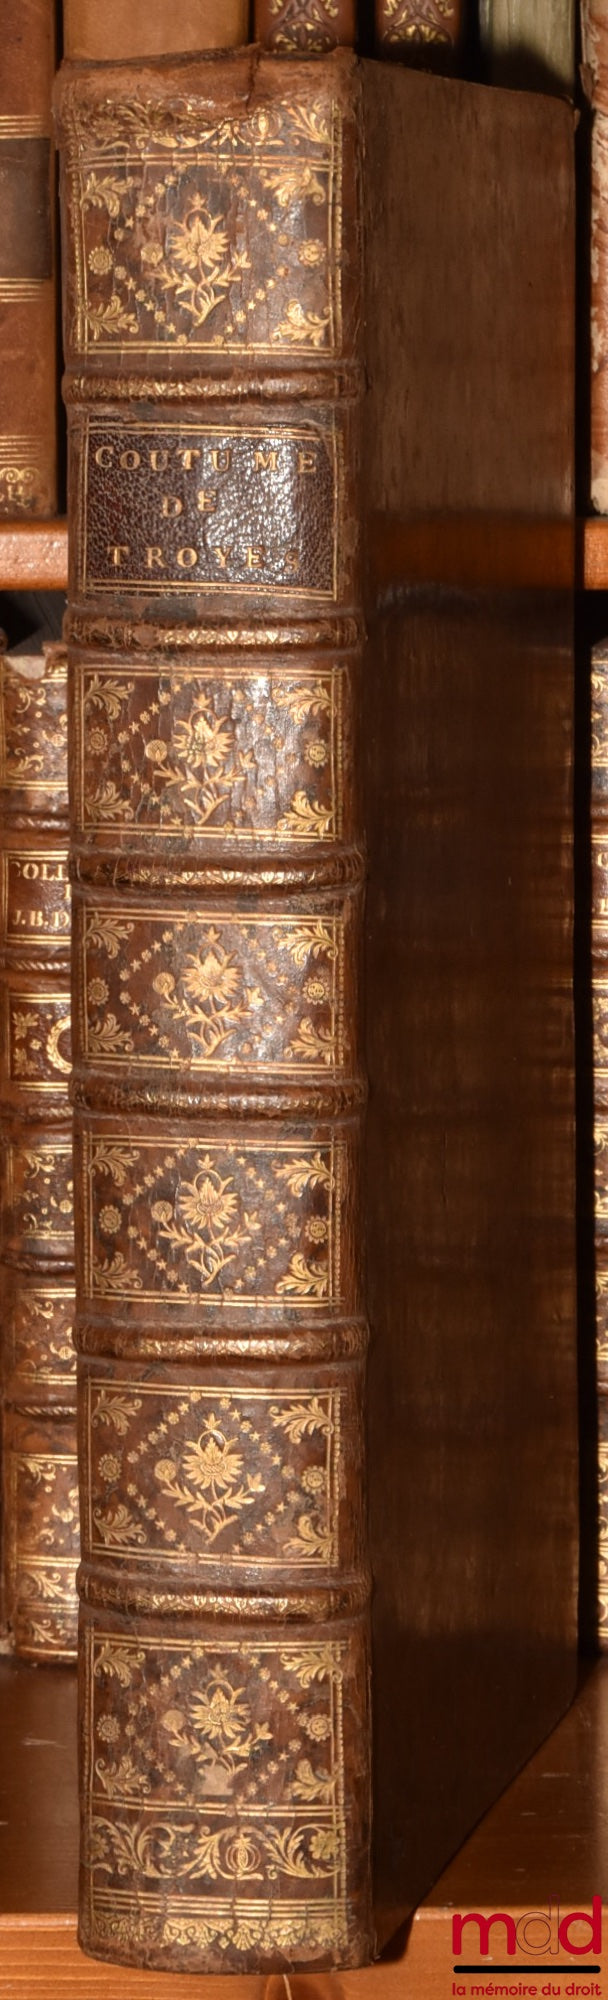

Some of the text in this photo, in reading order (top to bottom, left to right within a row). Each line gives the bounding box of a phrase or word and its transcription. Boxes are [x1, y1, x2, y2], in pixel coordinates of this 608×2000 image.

[95, 446, 317, 473] COUTUME
[161, 490, 217, 518] DE
[107, 546, 300, 574] TROYES
